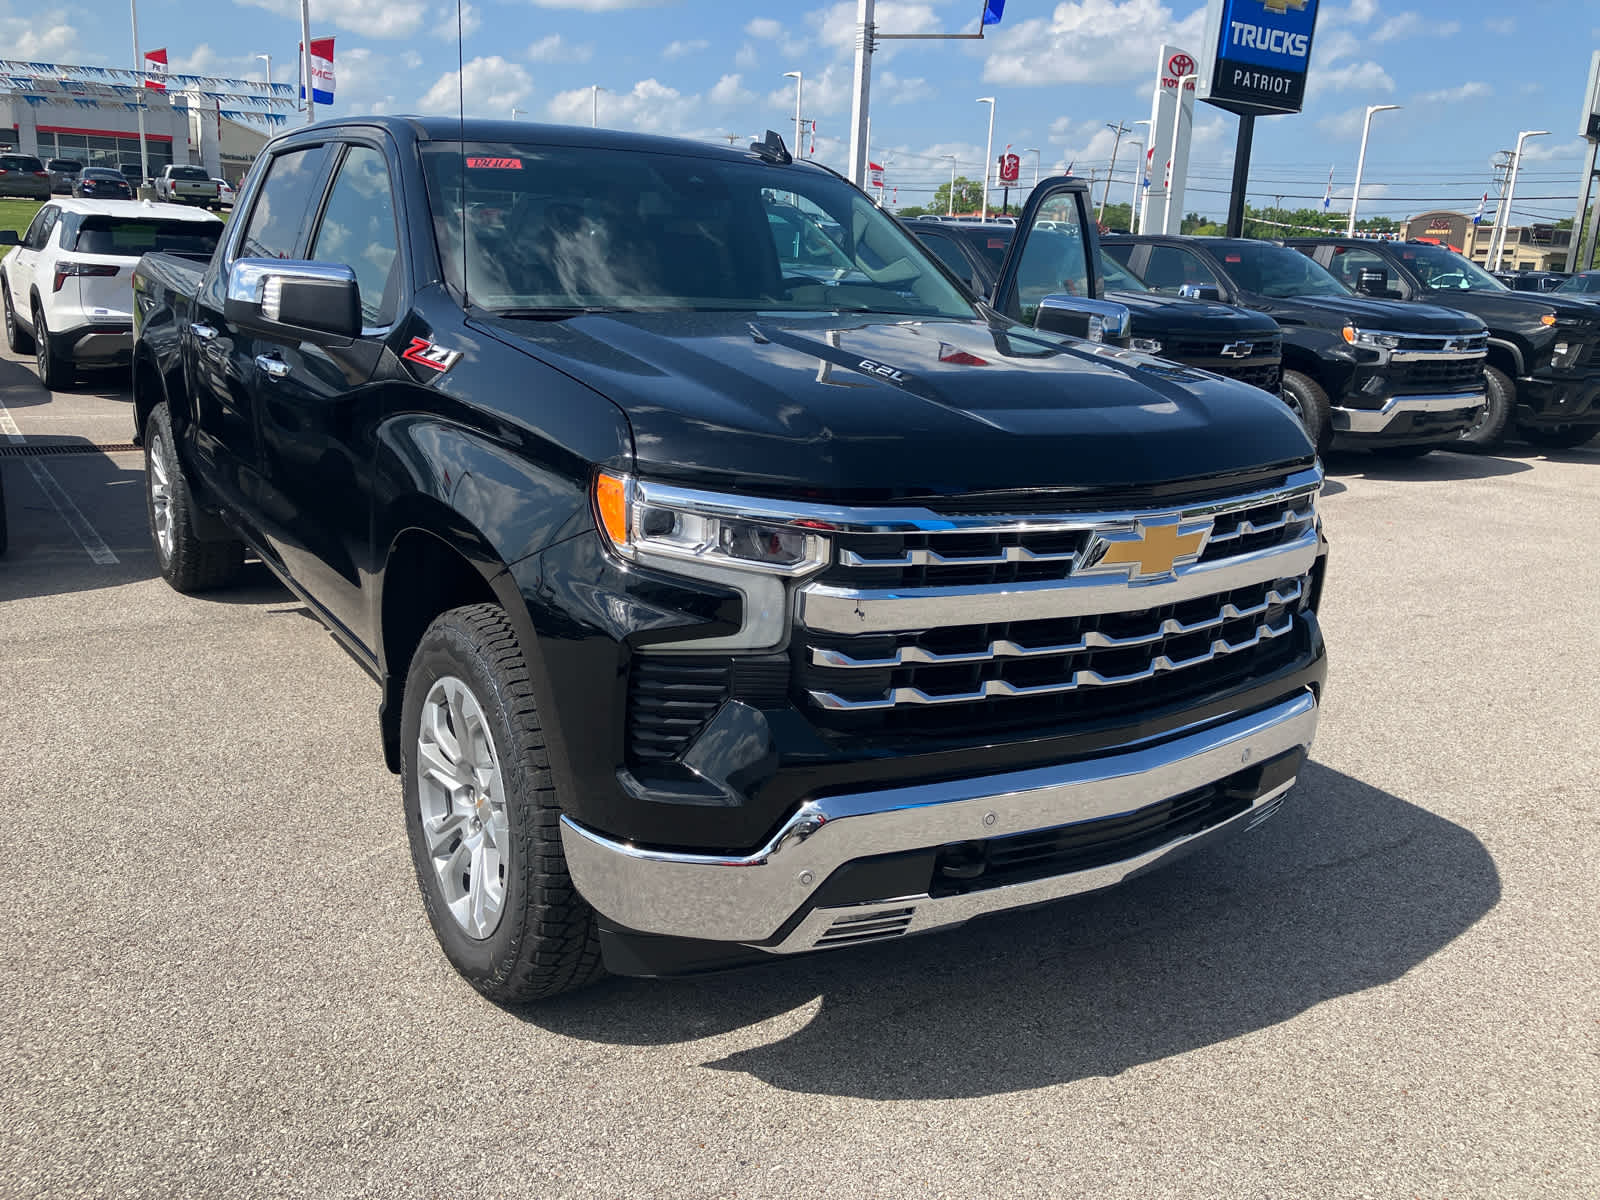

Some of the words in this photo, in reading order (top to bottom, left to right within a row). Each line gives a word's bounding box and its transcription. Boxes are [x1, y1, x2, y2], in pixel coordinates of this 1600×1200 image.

[1231, 21, 1309, 57] TRUCKS
[1161, 77, 1195, 91] TOYTA
[1233, 69, 1292, 94] PATRIOT
[402, 336, 464, 374] Z71
[858, 359, 904, 382] 6.2L
